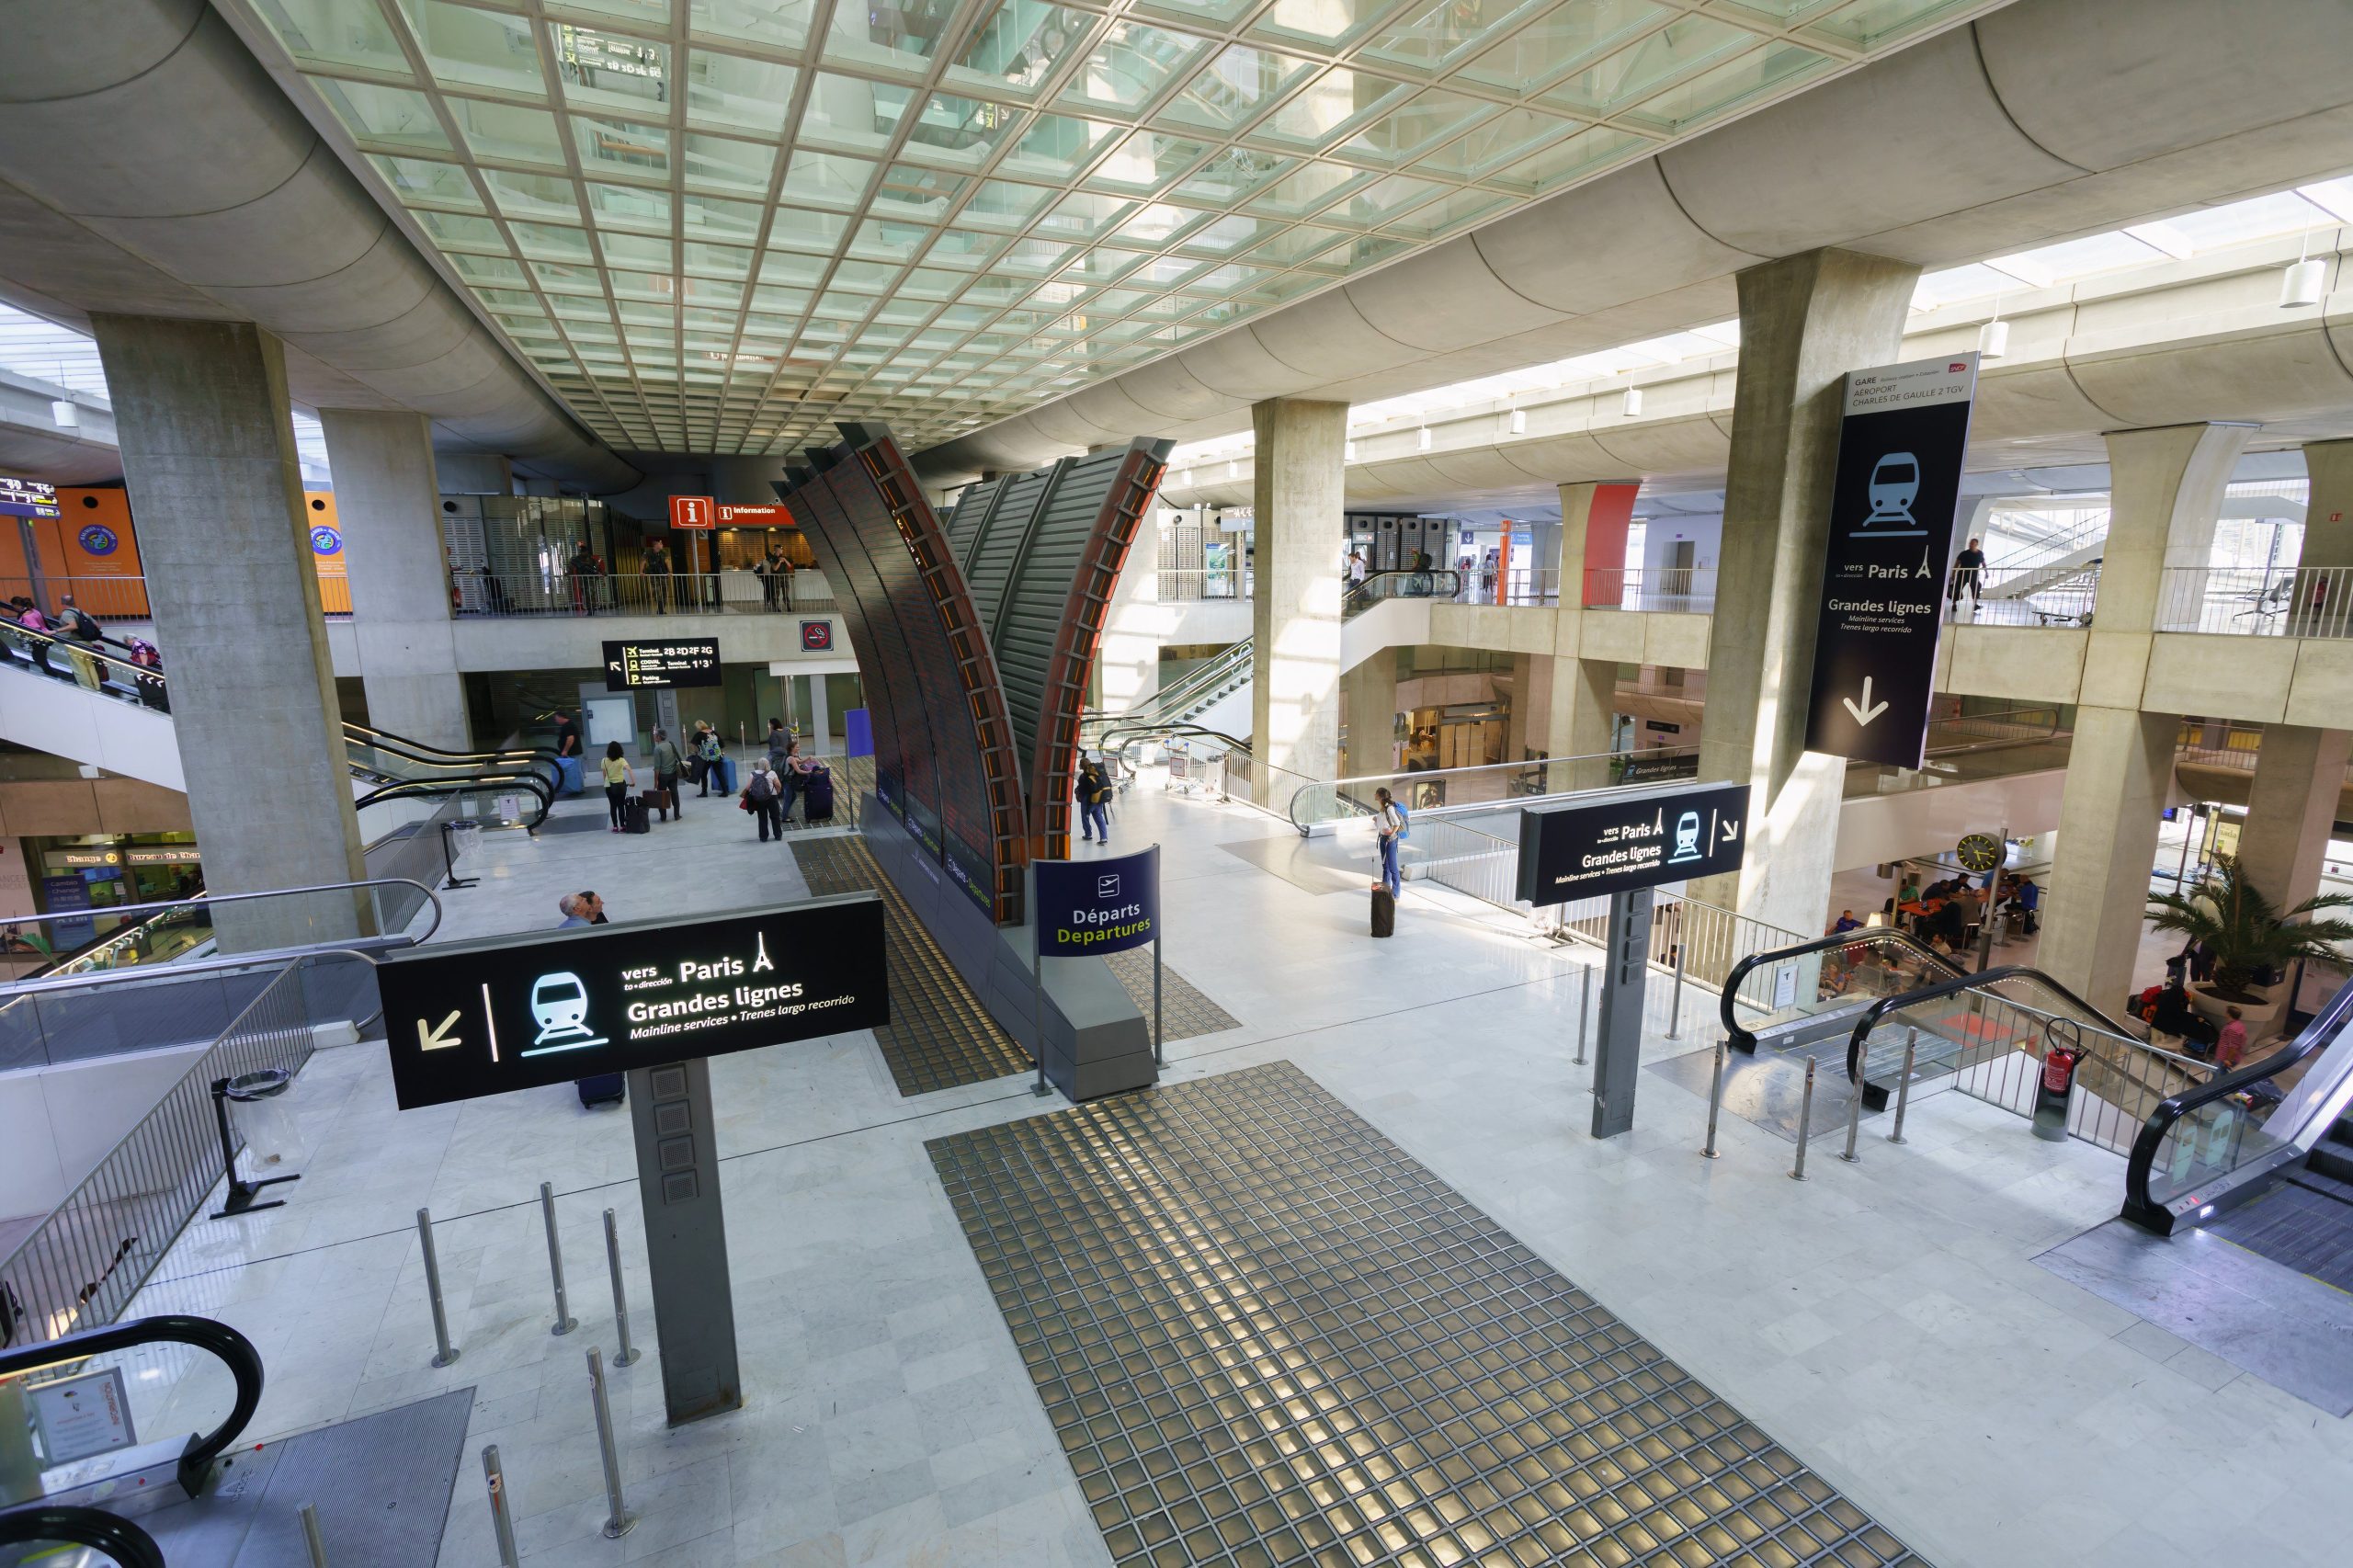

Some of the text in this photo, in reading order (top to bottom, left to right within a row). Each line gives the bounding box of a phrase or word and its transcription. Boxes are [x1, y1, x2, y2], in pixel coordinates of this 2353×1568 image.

[1855, 377, 1877, 386] GARE
[1852, 396, 1888, 406] CHARLES
[1903, 390, 1935, 400] GAULLE
[1947, 385, 1964, 394] TGV
[1868, 564, 1908, 579] Paris
[1828, 598, 1931, 616] Grandes lignes
[1848, 615, 1877, 623] Mainline
[1862, 625, 1879, 633] largo
[664, 647, 676, 656] 2B
[676, 647, 688, 655] 2D
[689, 646, 699, 655] 2F
[701, 646, 712, 654] 2G
[1636, 766, 1659, 775] Grandes
[1603, 824, 1650, 840] vers Paris
[66, 855, 101, 863] Change
[1582, 845, 1662, 868] Grandes lignes
[1555, 859, 1661, 884] Mainline services Trenes largo recorrido
[1073, 903, 1140, 926] Départs
[1057, 917, 1151, 946] Departures
[621, 956, 745, 983] vers Paris
[638, 978, 673, 990] dirección
[628, 982, 803, 1022] Grandes lignes
[630, 994, 855, 1040] Mainline services Trenes largo recorrido
